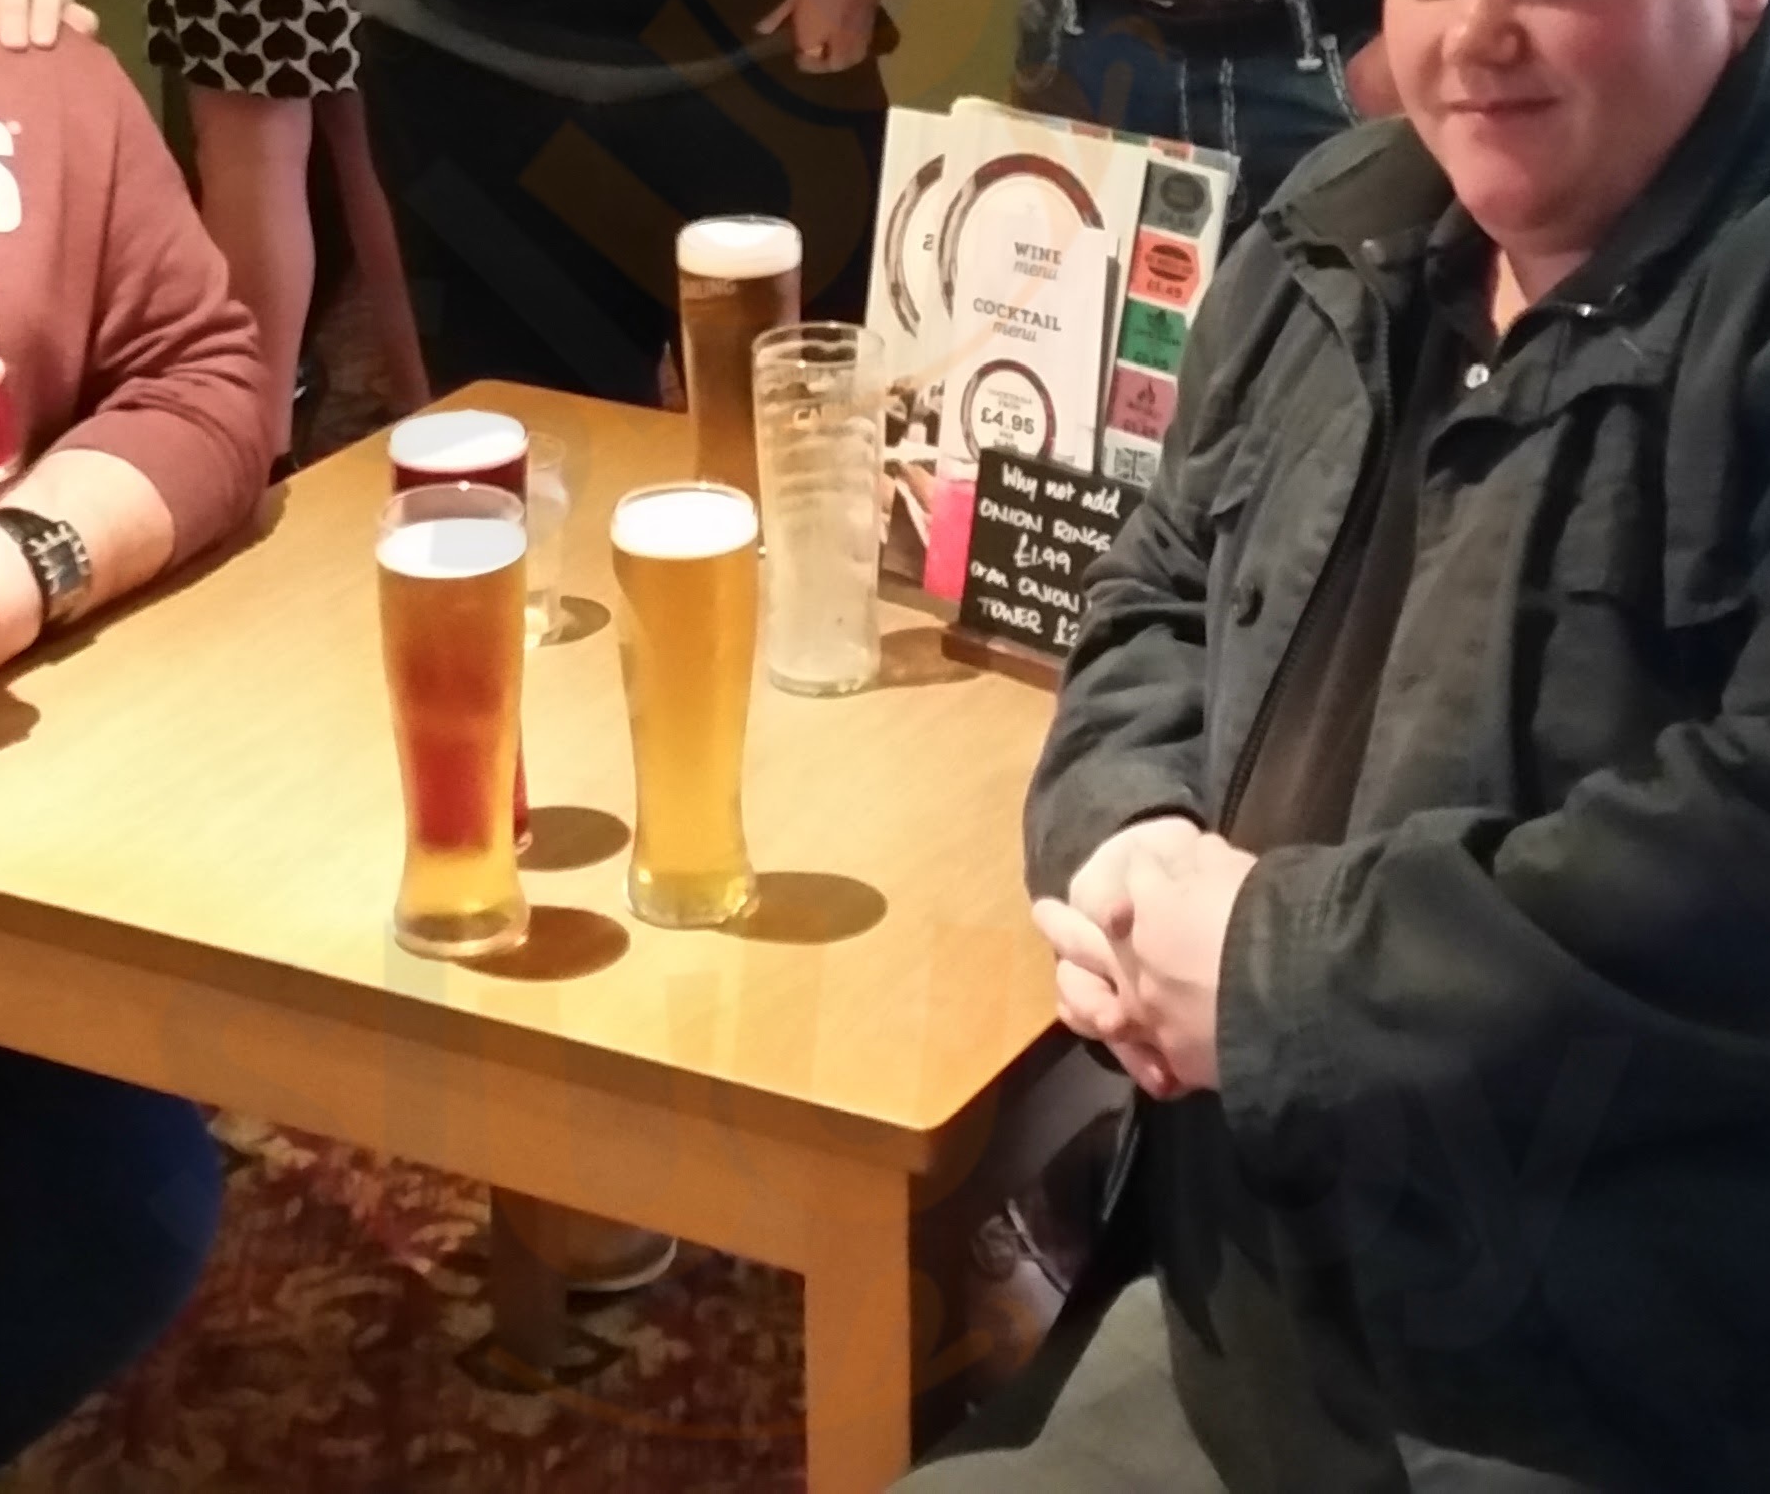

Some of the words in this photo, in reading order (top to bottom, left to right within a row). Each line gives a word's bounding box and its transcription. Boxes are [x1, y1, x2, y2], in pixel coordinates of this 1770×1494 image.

[1013, 260, 1058, 280] menu
[1014, 241, 1062, 265] WINE
[973, 297, 1062, 331] COCKTAIL
[992, 321, 1037, 342] menu
[1001, 461, 1038, 502] Why
[1045, 480, 1077, 502] not
[1081, 487, 1121, 519] add
[979, 497, 1043, 533] ONION
[1053, 518, 1112, 553] RINGS
[1017, 576, 1079, 615] ONION
[977, 596, 1044, 635] TOWER
